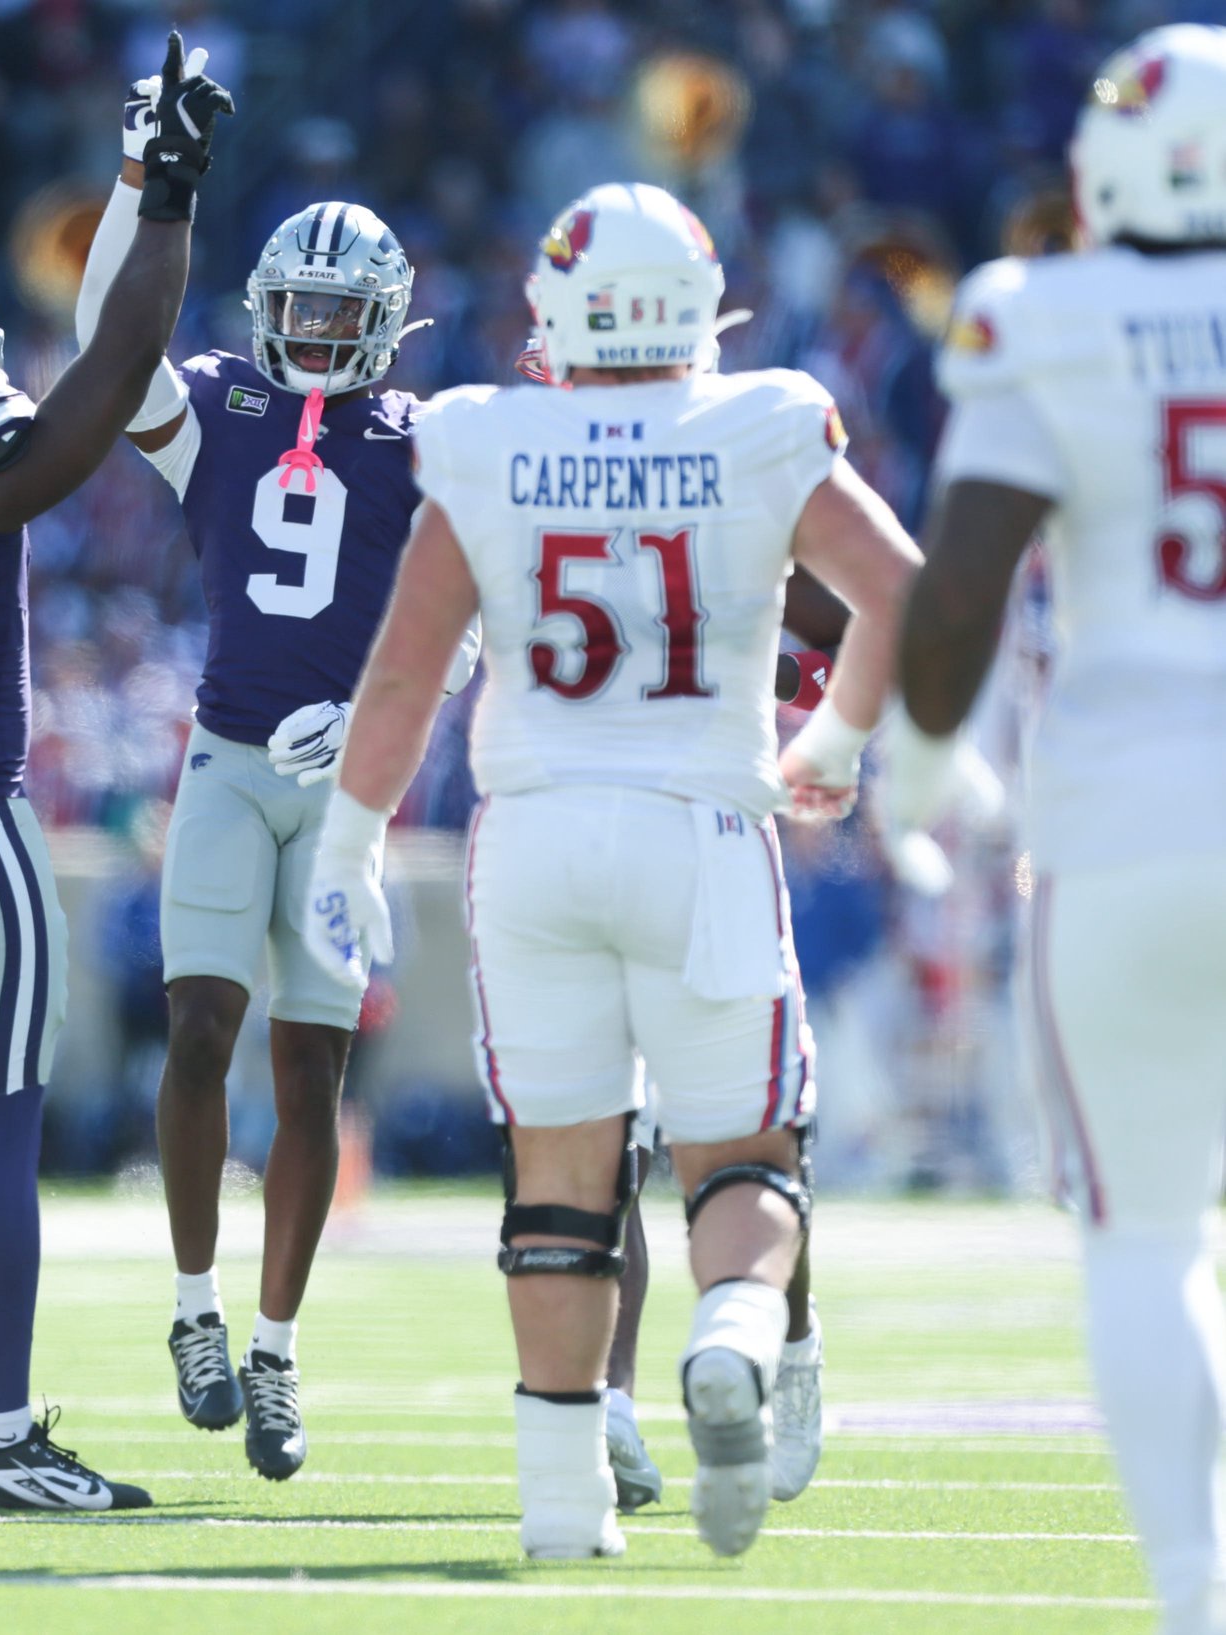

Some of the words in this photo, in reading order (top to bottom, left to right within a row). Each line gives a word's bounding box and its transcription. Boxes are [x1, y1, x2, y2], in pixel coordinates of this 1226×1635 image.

[298, 270, 338, 280] K-STATE
[631, 297, 666, 324] 51
[511, 453, 723, 509] CARPENTER
[245, 463, 348, 620] 9
[526, 523, 721, 704] 51
